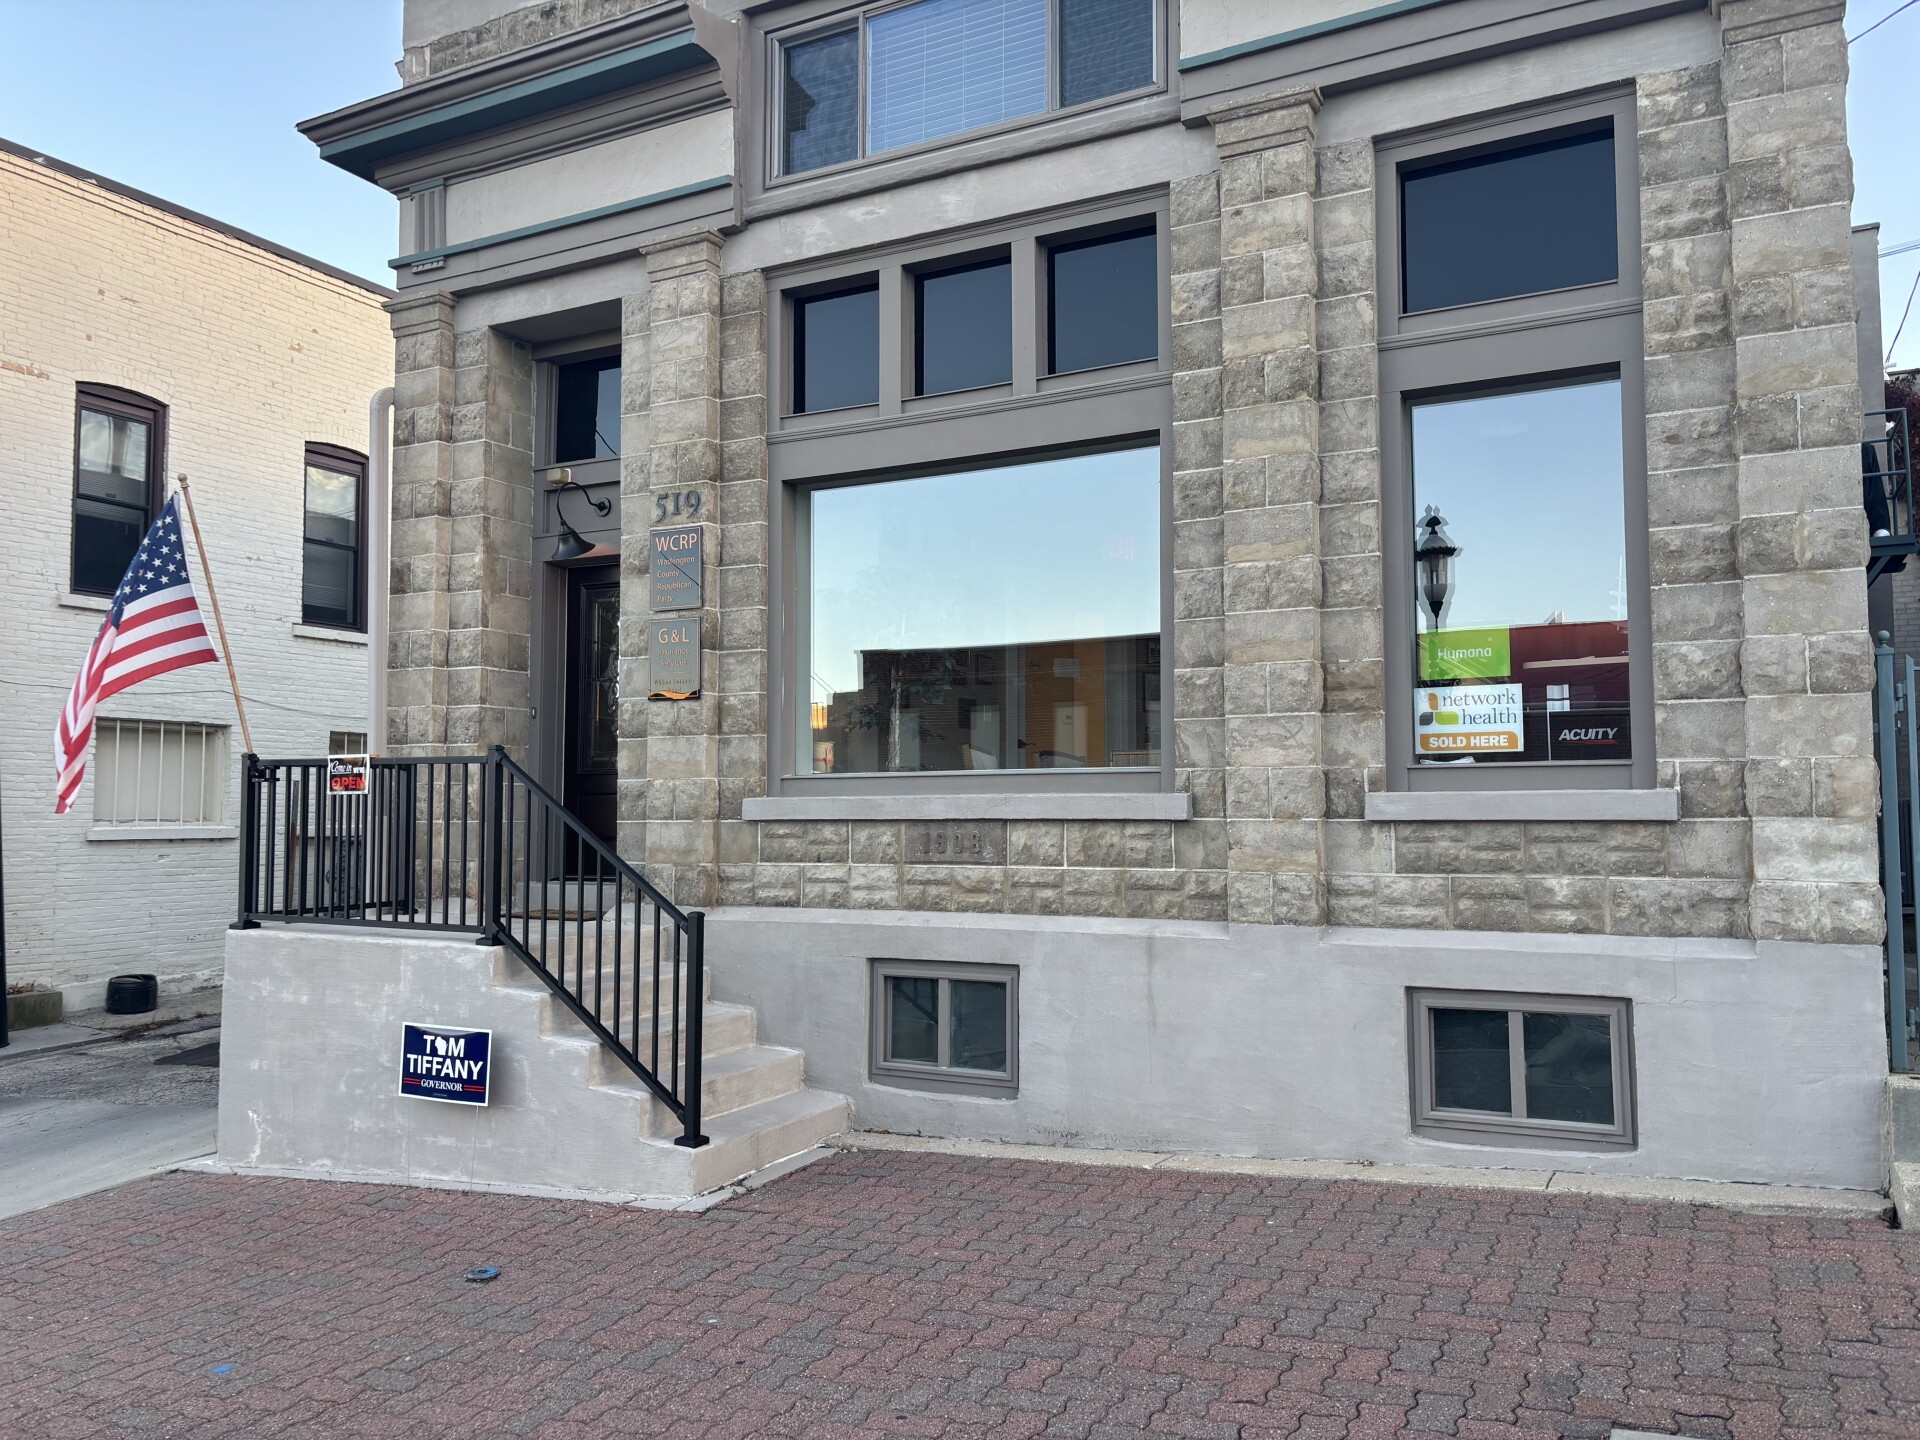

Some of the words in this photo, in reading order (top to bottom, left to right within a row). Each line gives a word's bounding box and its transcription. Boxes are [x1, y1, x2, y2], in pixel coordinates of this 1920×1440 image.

[655, 490, 700, 522] 519
[656, 533, 698, 552] WCRP
[657, 556, 695, 567] Washington
[657, 570, 680, 579] County
[657, 581, 692, 592] Republican
[657, 595, 674, 603] Party
[658, 647, 690, 656] Insurance
[1437, 647, 1492, 660] Humana
[660, 660, 688, 668] Services
[1442, 688, 1517, 707] network
[1461, 707, 1518, 725] health
[1558, 727, 1618, 741] ACUITY
[1429, 736, 1467, 748] SOLD
[1470, 735, 1509, 747] HERE
[331, 776, 365, 790] OPEN
[406, 1053, 484, 1080] TIFFANY
[421, 1078, 463, 1092] GOVERNOR
